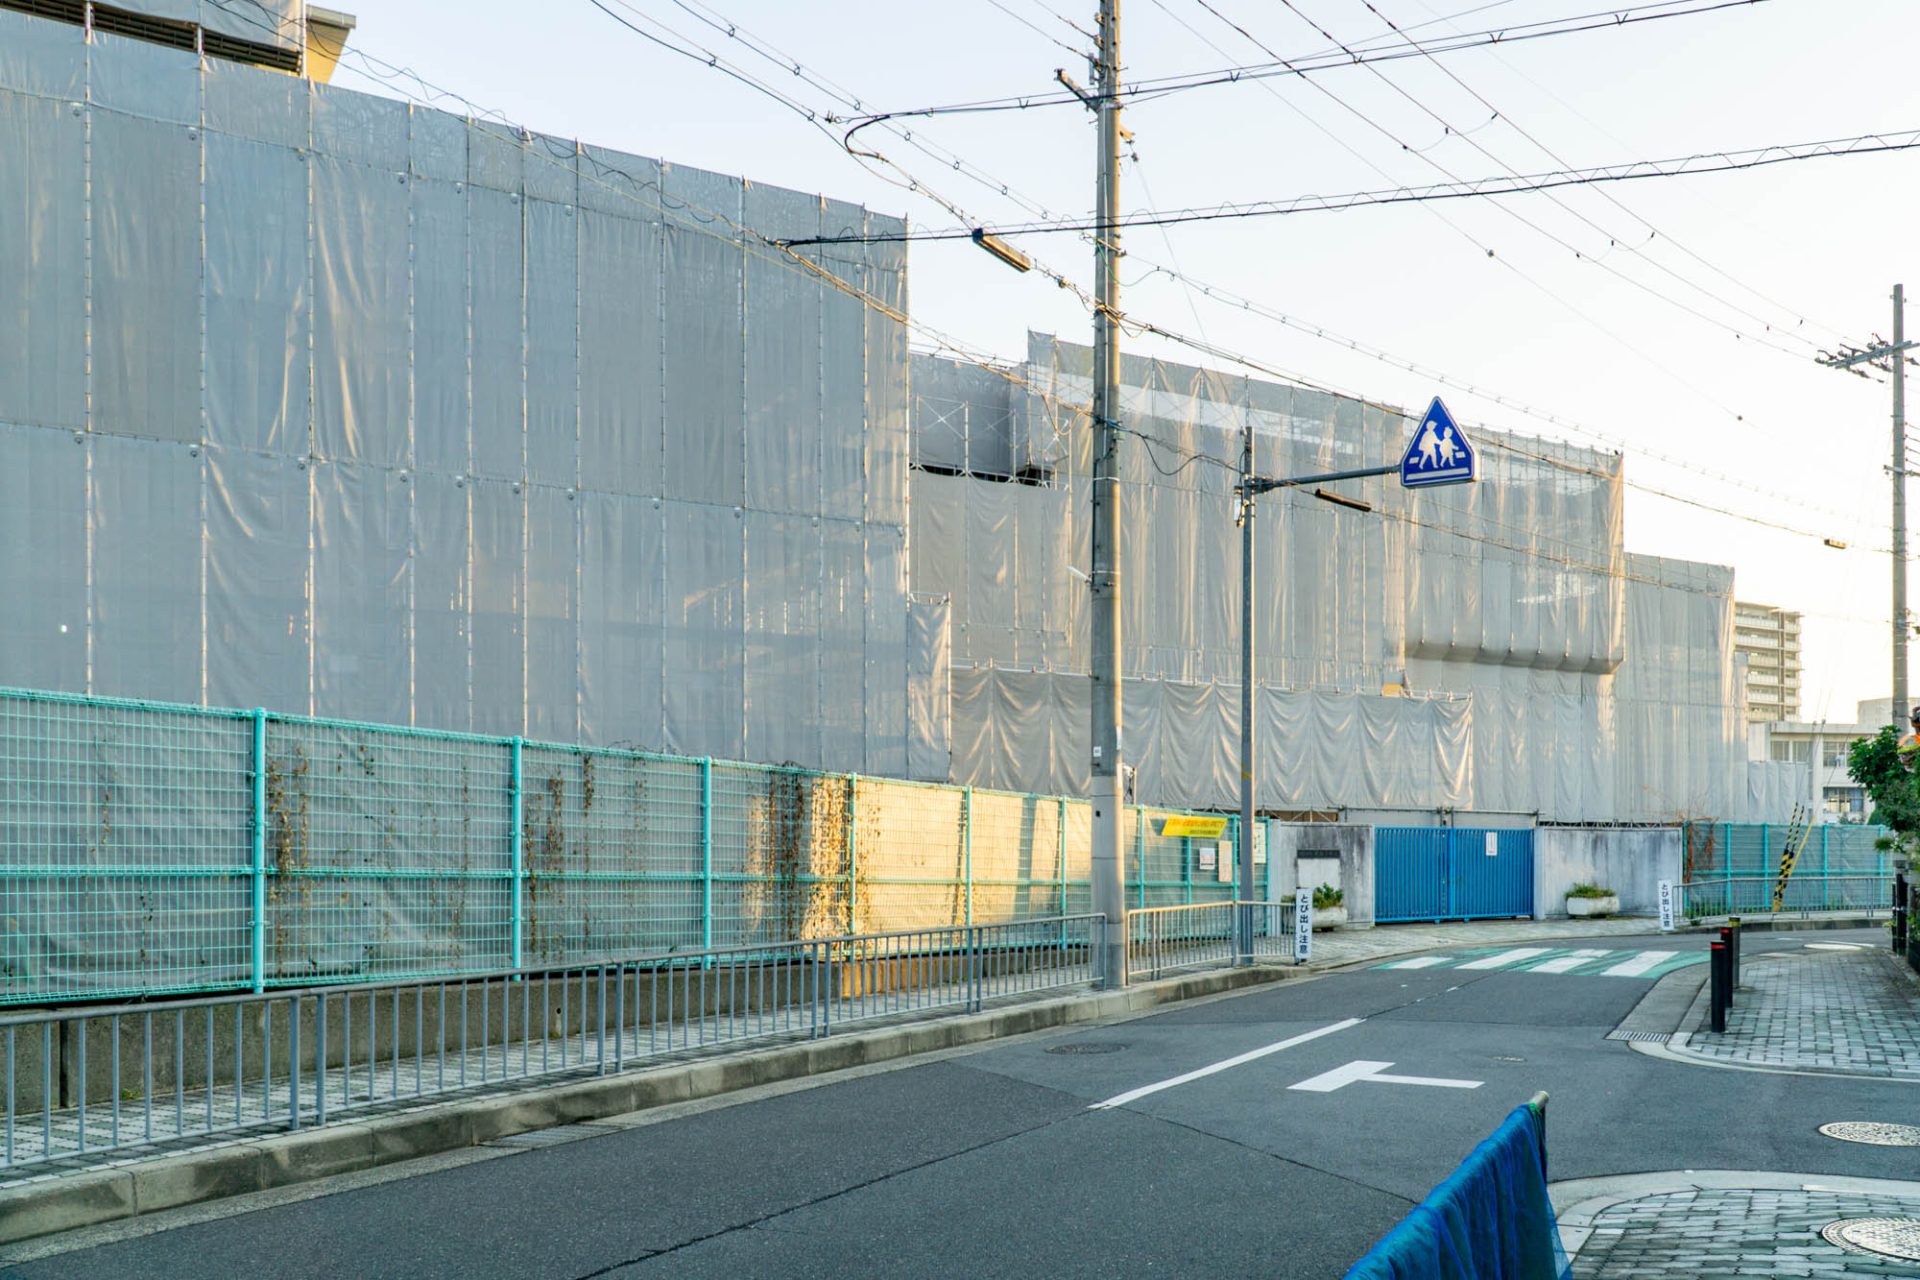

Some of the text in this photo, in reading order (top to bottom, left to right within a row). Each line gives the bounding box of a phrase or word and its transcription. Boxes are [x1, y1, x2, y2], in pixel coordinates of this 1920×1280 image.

[1299, 893, 1308, 954] とび出し注意
[1661, 884, 1670, 927] とび出し注意
